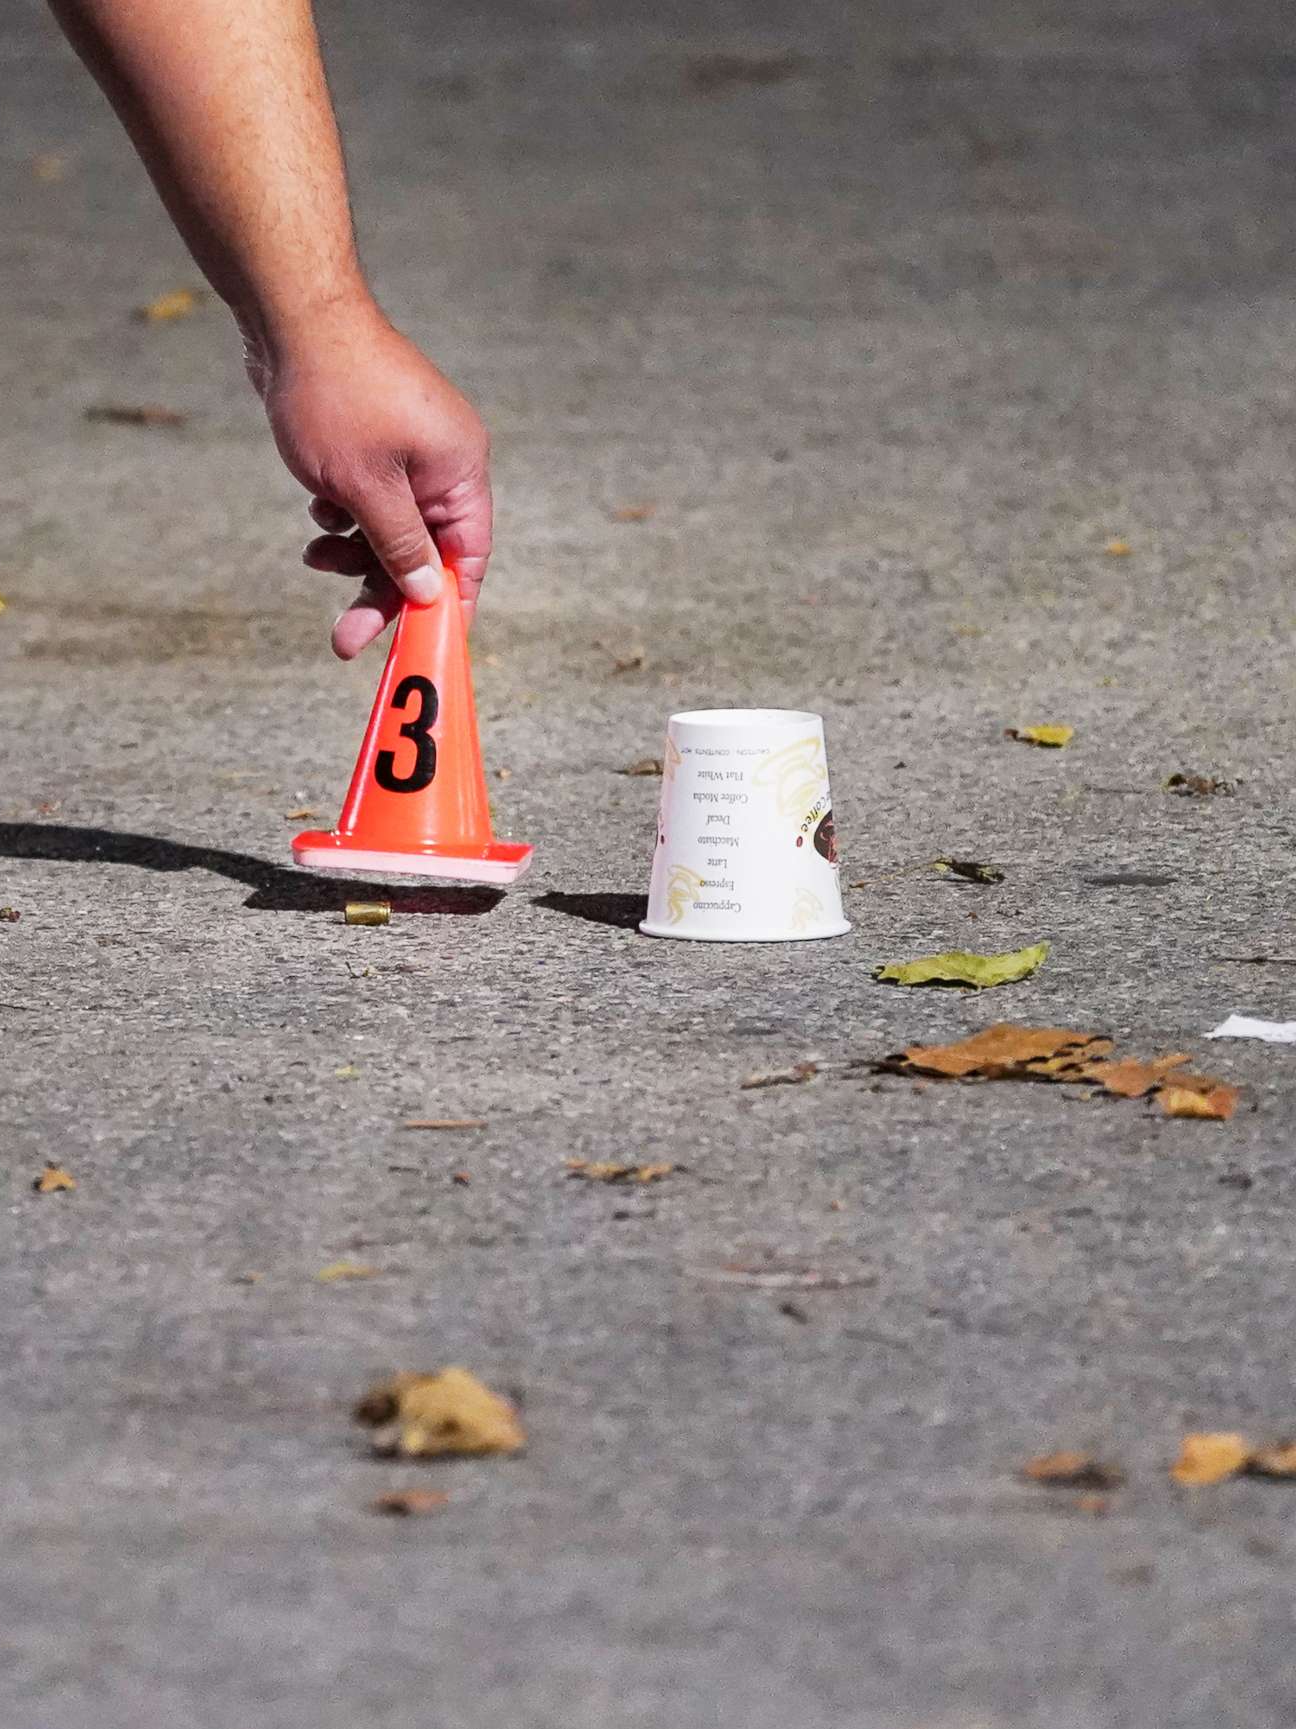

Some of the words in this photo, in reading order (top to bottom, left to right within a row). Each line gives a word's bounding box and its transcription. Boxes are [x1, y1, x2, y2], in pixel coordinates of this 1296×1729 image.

[374, 675, 439, 793] 3
[698, 771, 724, 780] White
[727, 772, 743, 780] Flat
[693, 793, 719, 802] Mocha
[723, 794, 748, 803] Coffee
[706, 815, 730, 825] Decaf
[698, 837, 739, 847] Macchiato
[708, 859, 727, 868] Latte
[700, 879, 734, 891] Espresso
[693, 902, 742, 912] Cappuccino
